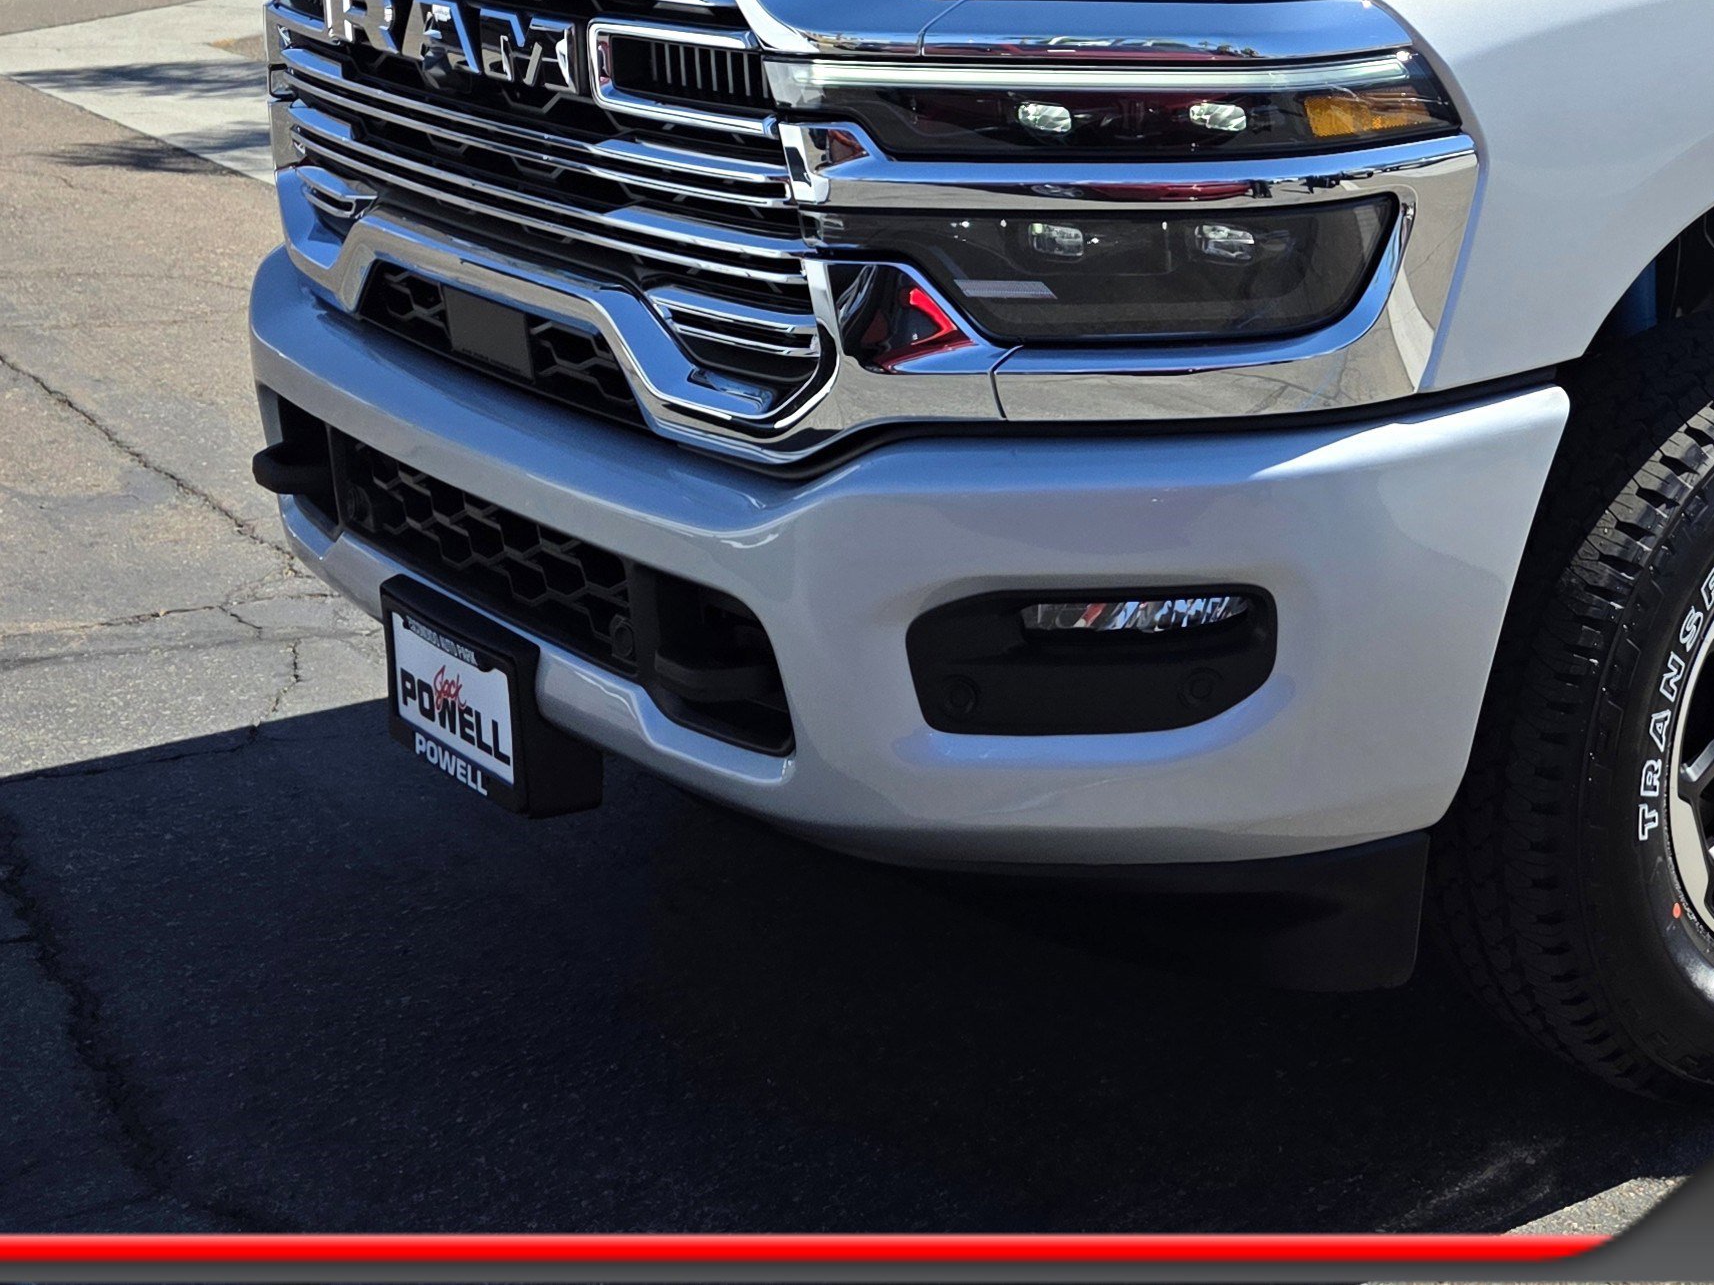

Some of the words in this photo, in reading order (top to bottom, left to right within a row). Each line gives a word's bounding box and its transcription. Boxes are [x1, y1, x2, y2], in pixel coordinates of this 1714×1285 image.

[401, 668, 512, 767] POWELL
[433, 665, 467, 711] Jack
[414, 731, 488, 797] POWELL
